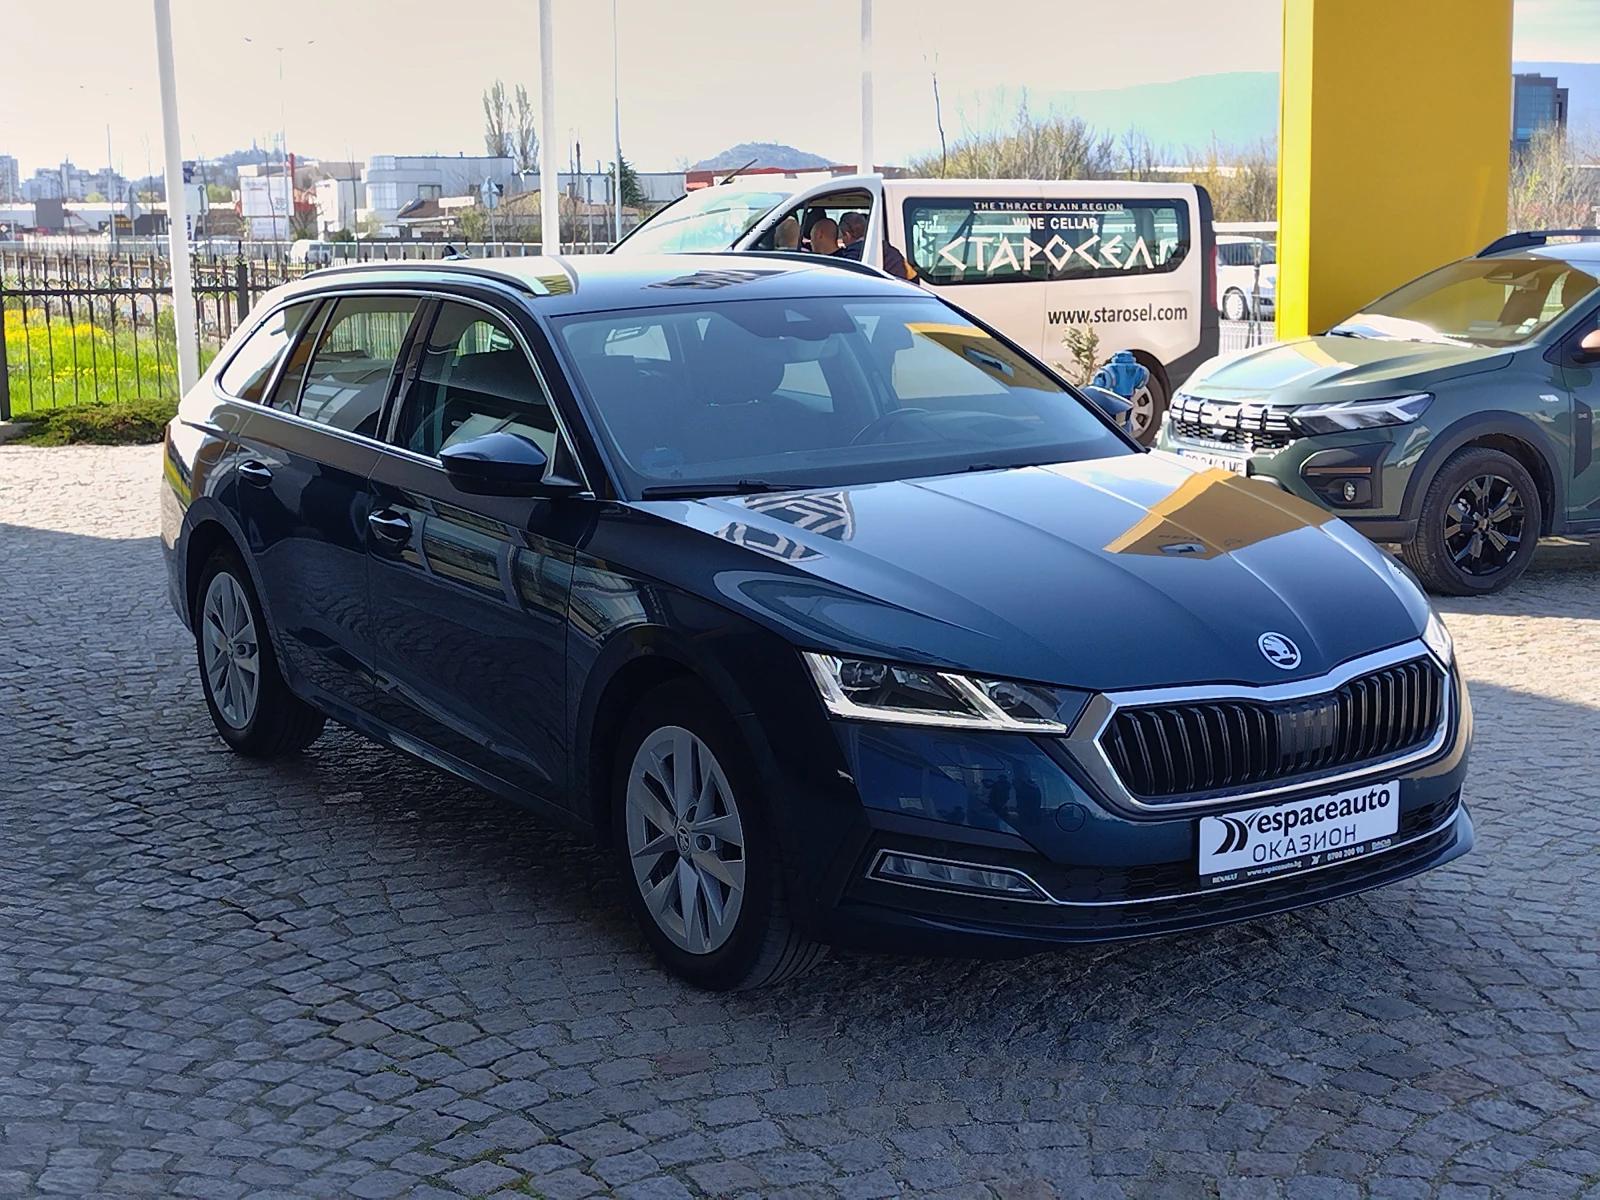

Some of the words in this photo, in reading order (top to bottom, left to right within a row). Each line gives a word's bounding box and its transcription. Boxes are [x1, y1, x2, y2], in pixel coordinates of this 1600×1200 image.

[973, 202, 996, 210] THE
[999, 202, 1043, 210] THRACE
[1046, 202, 1079, 210] PLAIN
[1082, 202, 1124, 211] REGION
[1012, 217, 1045, 230] WINE
[1050, 217, 1098, 230] CELLAR
[1048, 303, 1188, 325] www.starosel.com
[1257, 788, 1390, 837] espaceauto
[1252, 824, 1357, 863] ОКАЗИОН
[1212, 872, 1238, 884] RENAULT
[1327, 851, 1343, 861] 0700
